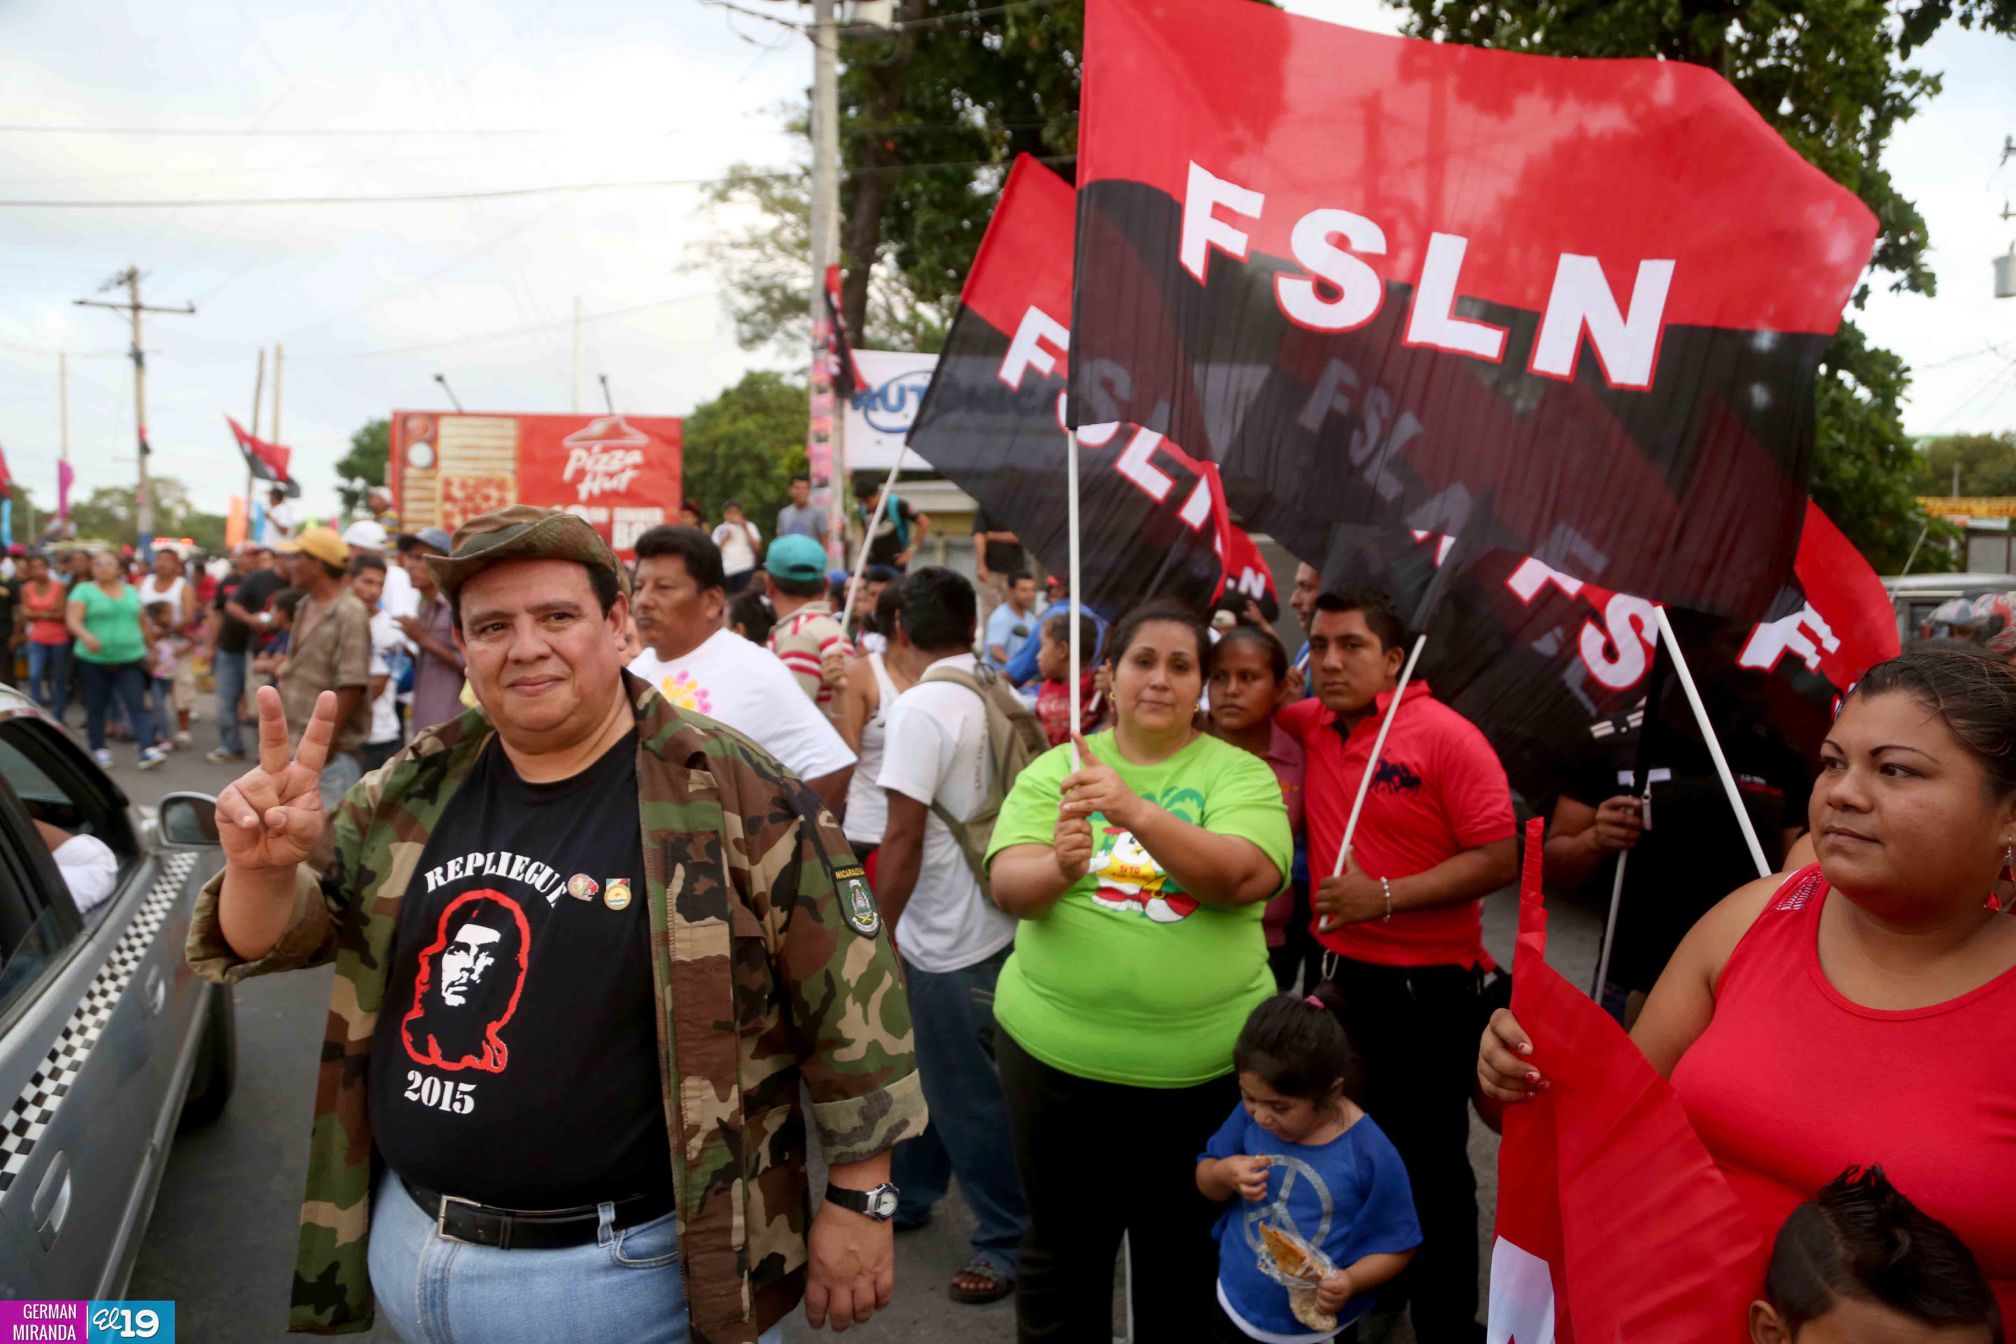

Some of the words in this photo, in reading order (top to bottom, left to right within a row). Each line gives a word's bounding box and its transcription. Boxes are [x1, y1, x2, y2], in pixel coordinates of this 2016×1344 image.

[1180, 160, 1676, 388] FSLN
[563, 443, 644, 482] Pizza
[576, 467, 640, 502] Hut
[403, 1070, 478, 1115] 2015
